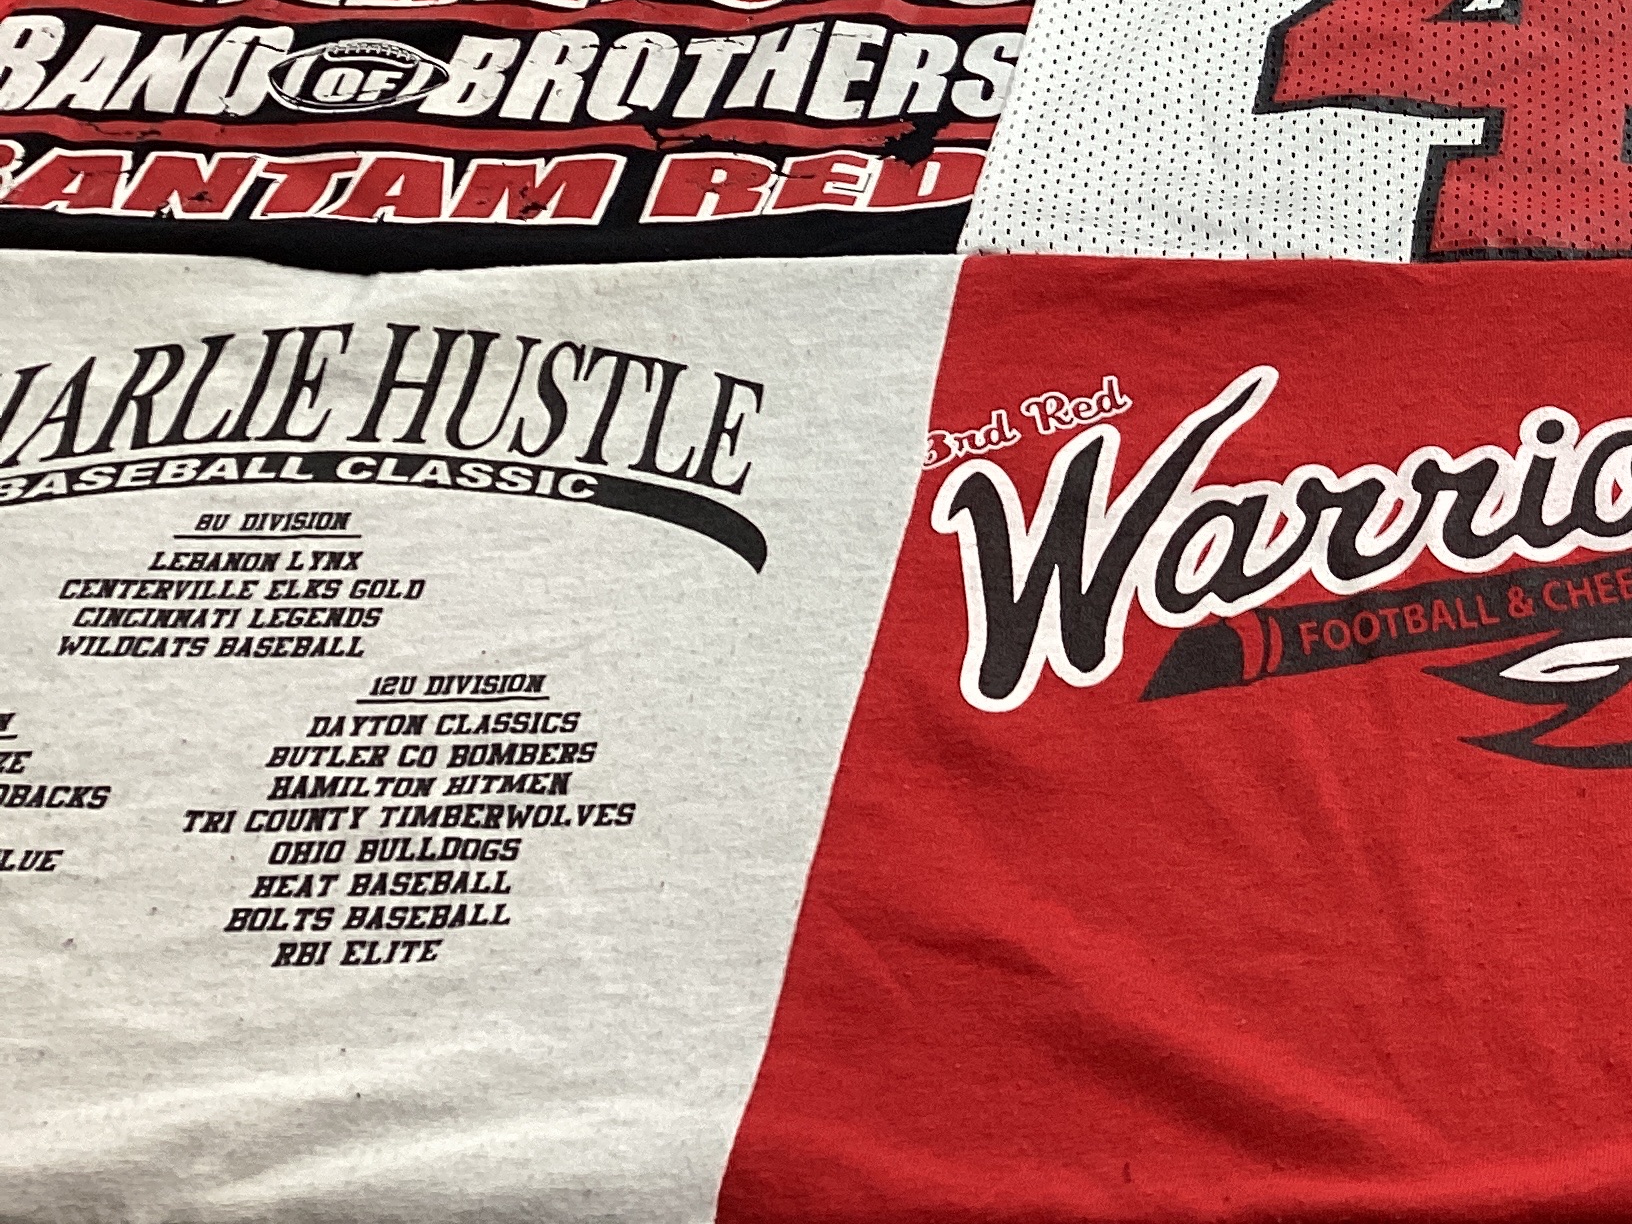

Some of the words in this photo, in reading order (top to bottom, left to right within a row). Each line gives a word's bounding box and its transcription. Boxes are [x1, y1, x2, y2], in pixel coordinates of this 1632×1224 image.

[0, 14, 296, 117] BAND
[311, 66, 405, 105] OF
[417, 20, 1026, 124] BROTHERS
[638, 145, 988, 225] RED
[347, 322, 768, 497] HUSTLE
[921, 409, 1022, 471] 3rd
[1019, 374, 1134, 436] Red
[0, 453, 318, 503] BASEBALL
[335, 454, 600, 502] CLASSIC
[194, 512, 230, 532] 8U
[238, 511, 353, 532] DIVISION
[148, 550, 282, 572] LEBANON
[284, 550, 364, 572] LYNX
[57, 578, 260, 601] CENTERVILLE
[264, 579, 342, 601] ELKS
[348, 578, 427, 601] GOLD
[71, 607, 242, 629] CINCINNATI
[247, 607, 385, 629] LEGENDS
[1299, 584, 1501, 657] FOOTBALL
[1506, 584, 1536, 618] &
[57, 635, 210, 658] WILDCATS
[213, 635, 366, 658] BASEBALL
[369, 675, 418, 697] 12U
[423, 673, 548, 697] DIVISION
[306, 713, 428, 739] DAYTON
[433, 711, 582, 736] CLASSICS
[264, 744, 390, 770] BUTLER
[399, 744, 438, 769] CO
[445, 741, 599, 767] BOMBERS
[266, 775, 435, 802] HAMILTON
[442, 772, 574, 798] HITMEN
[182, 809, 238, 835] TRI
[243, 806, 370, 834] COUNTY
[378, 802, 638, 832] TIMBERWOLVES
[267, 839, 348, 866] OHIO
[354, 836, 523, 865] BULLDOGS
[249, 873, 340, 900] HEAT
[345, 870, 513, 898] BASEBALL
[222, 906, 335, 933] BOLTS
[341, 902, 511, 931] BASEBALL
[270, 941, 330, 969] RBI
[338, 938, 444, 967] ELITE
